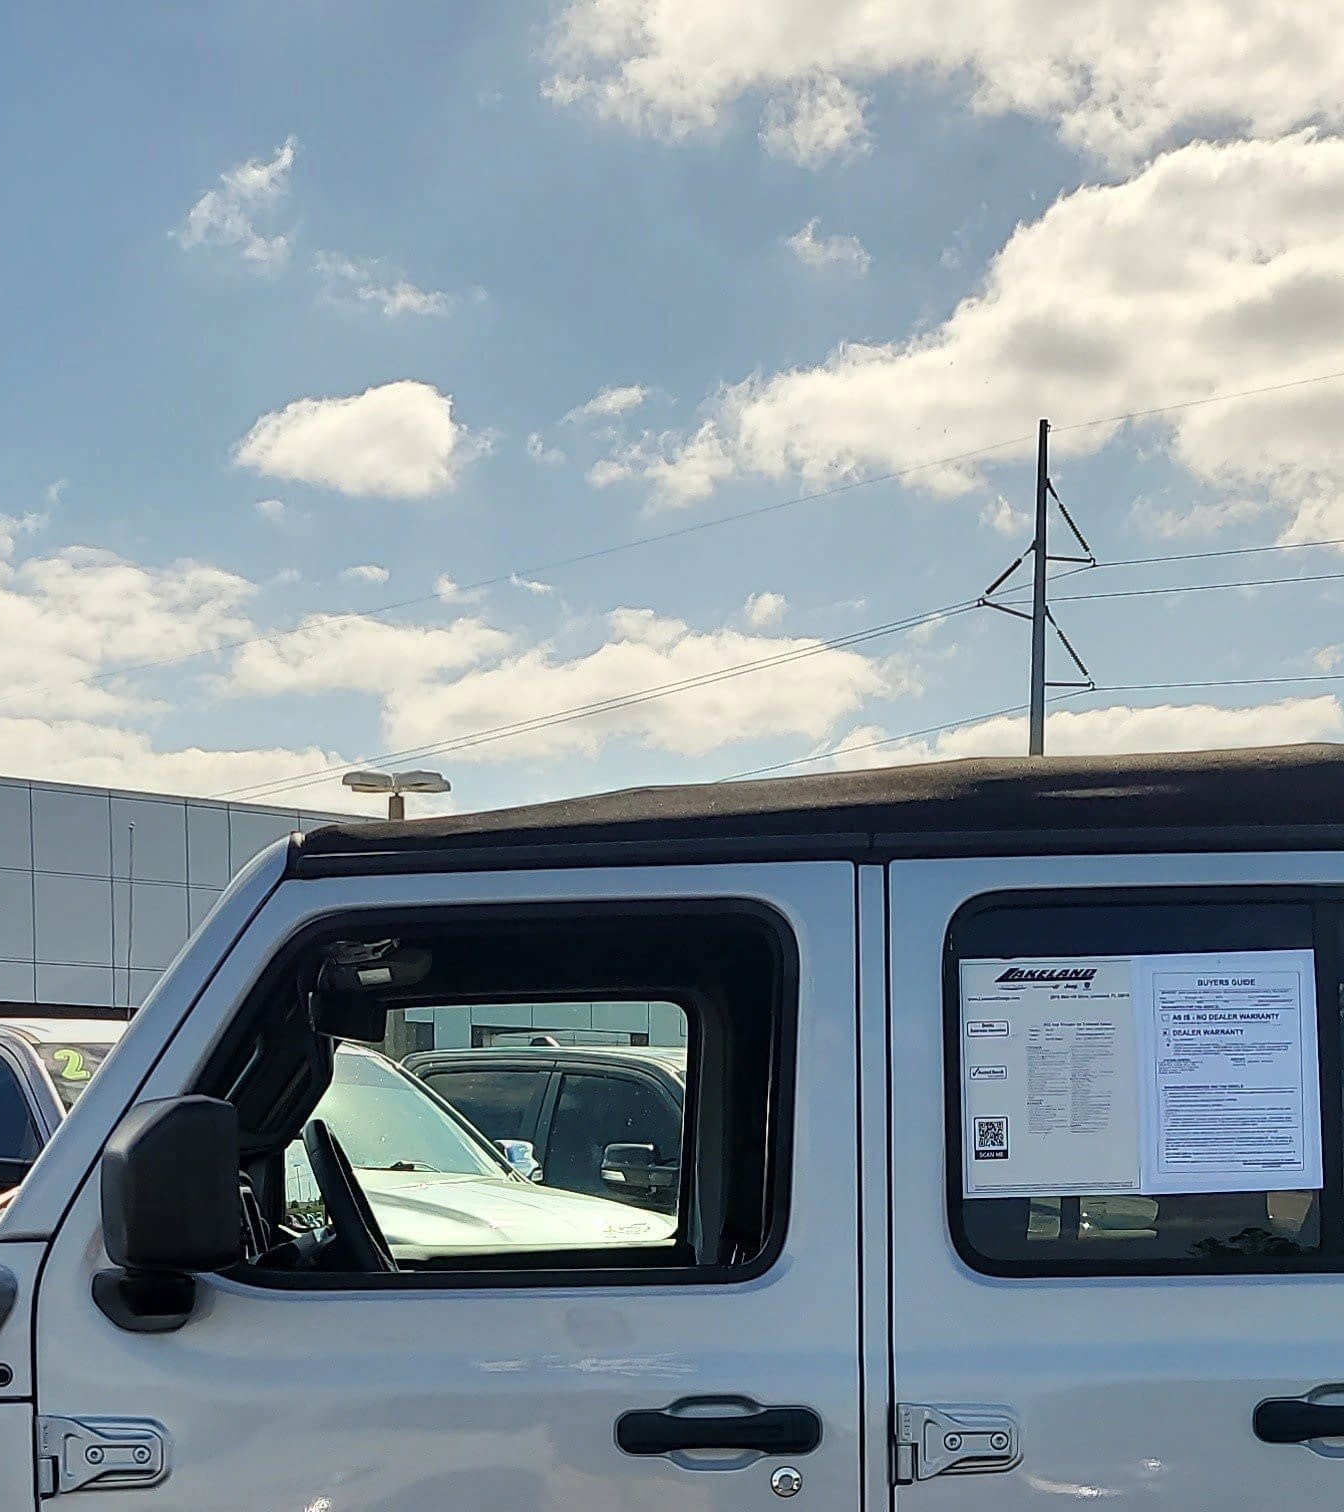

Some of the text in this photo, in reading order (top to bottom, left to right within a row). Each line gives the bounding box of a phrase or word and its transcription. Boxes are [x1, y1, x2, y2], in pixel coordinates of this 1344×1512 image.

[994, 967, 1098, 983] LAKELAND
[1197, 978, 1256, 986] BUYERS GUIDE
[1196, 1013, 1207, 1021] NO
[1208, 1013, 1238, 1021] DEALER
[1172, 1028, 1244, 1037] DEALER WARRANTY
